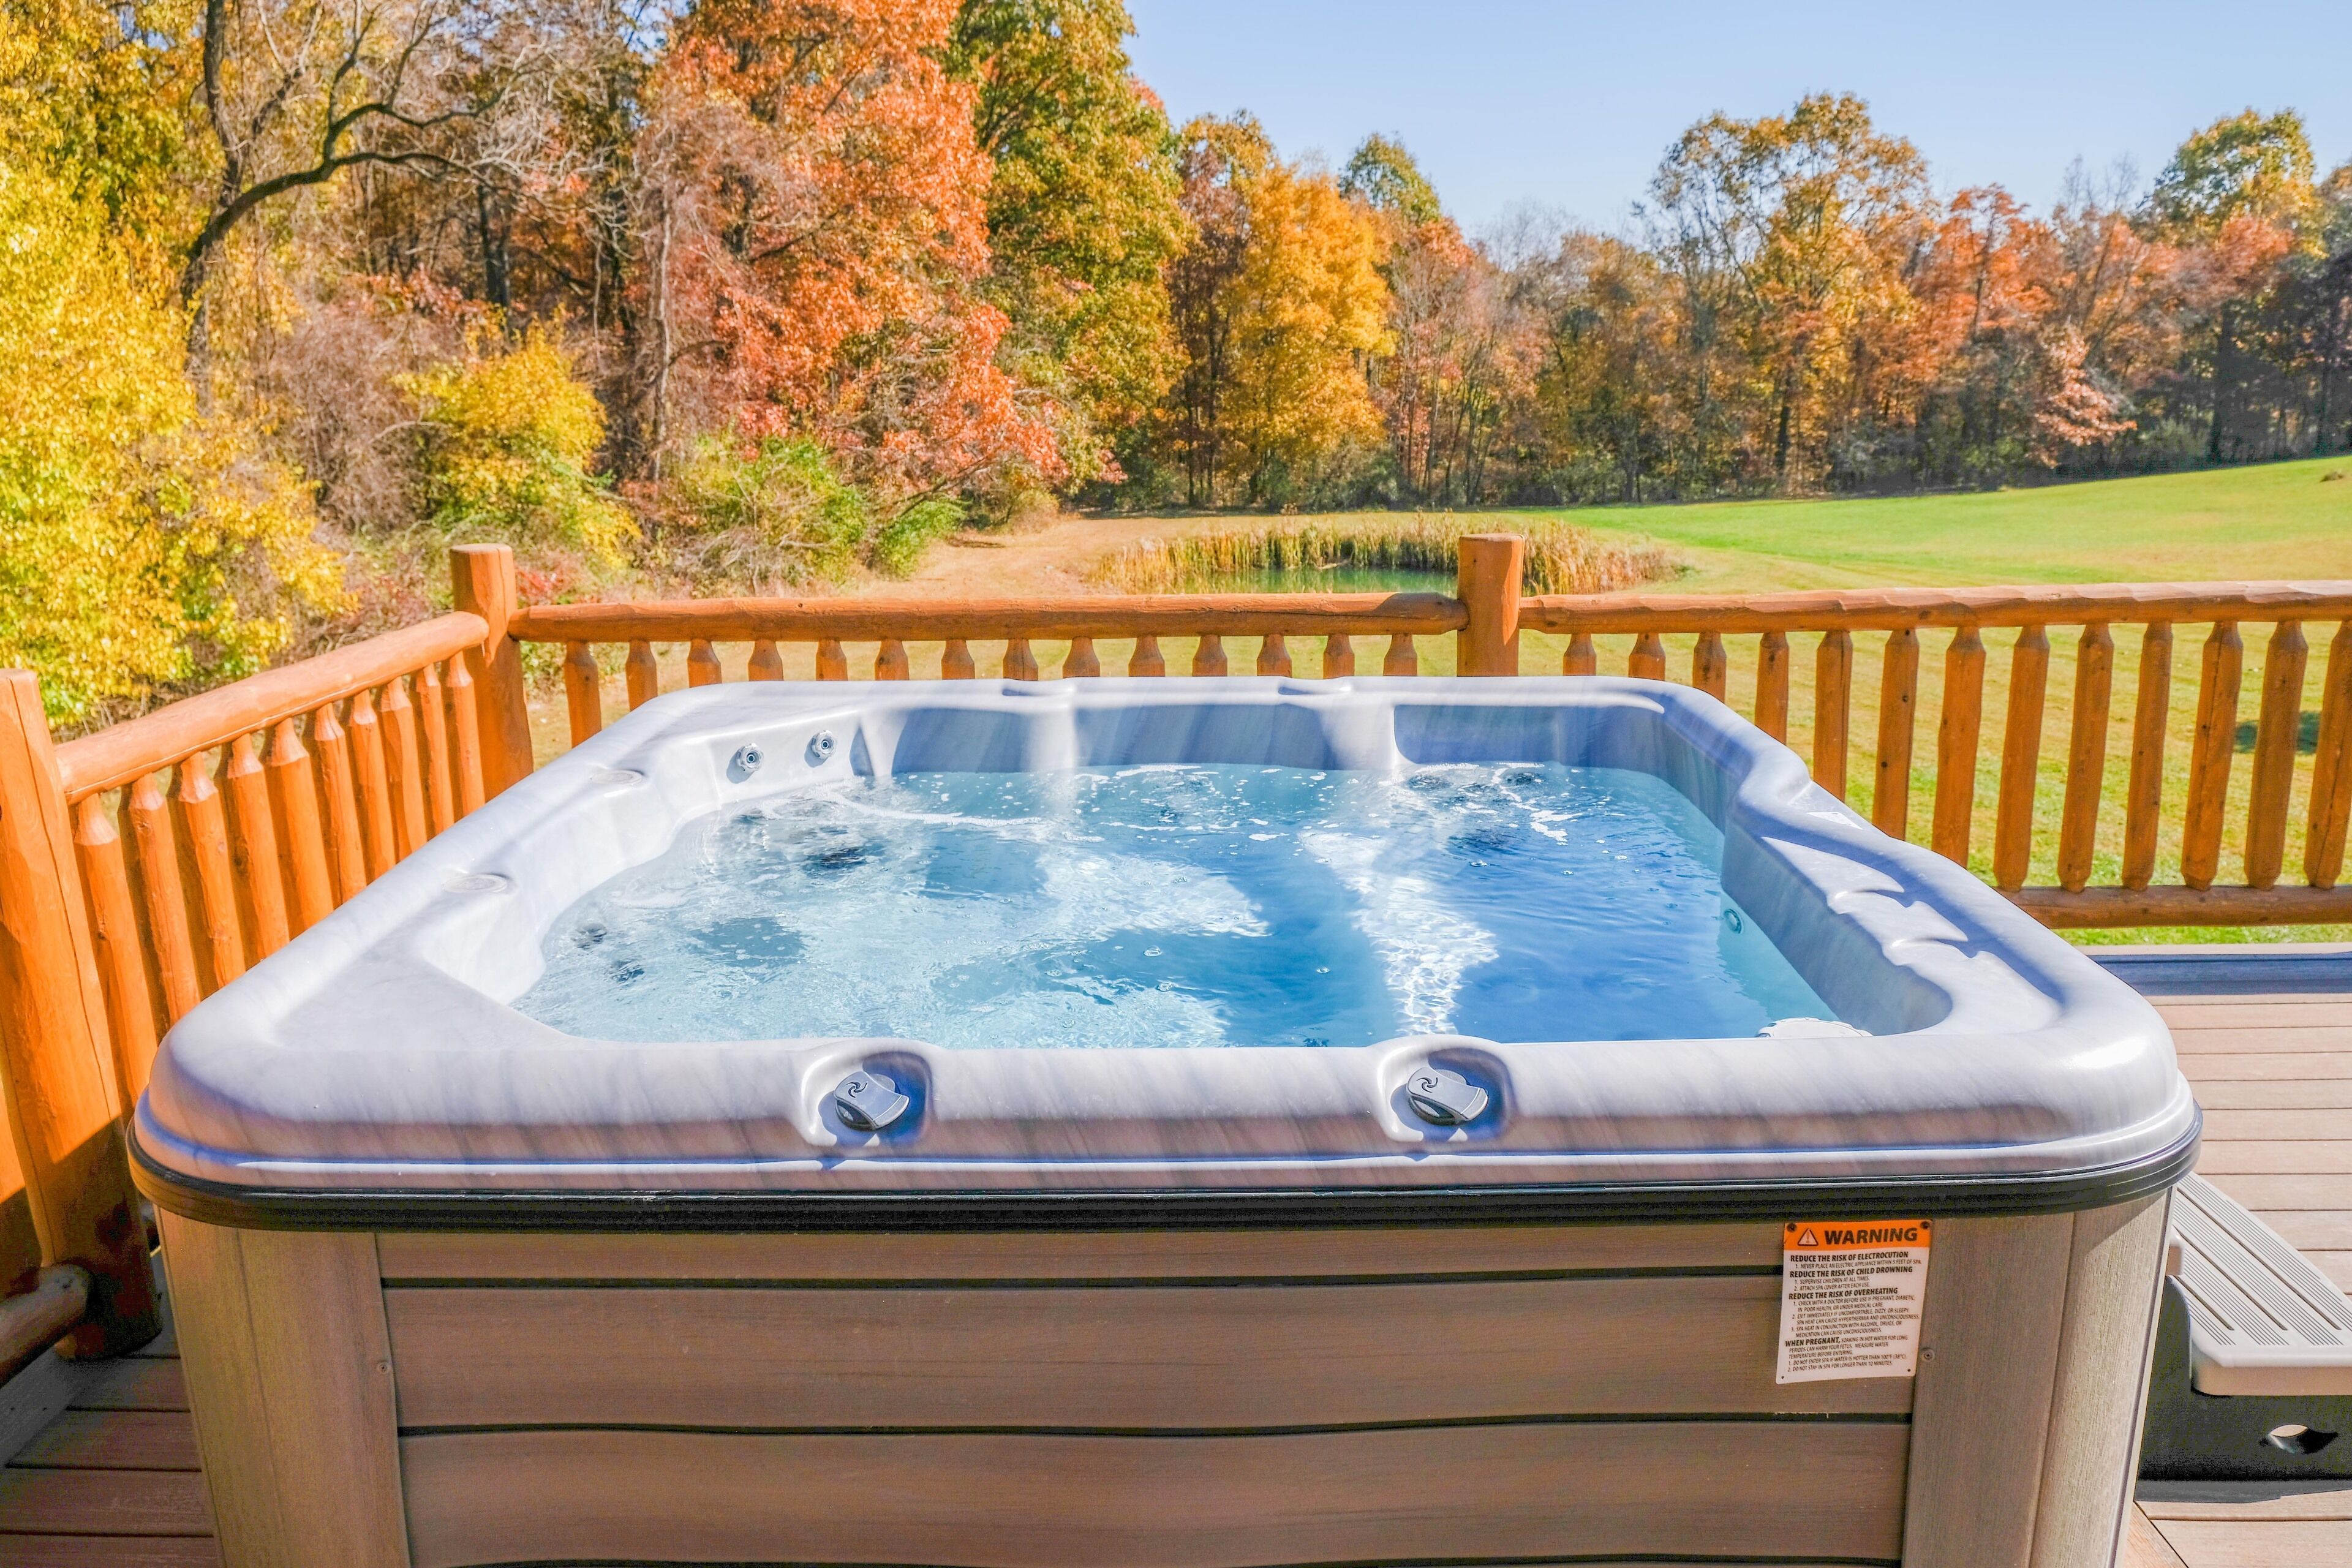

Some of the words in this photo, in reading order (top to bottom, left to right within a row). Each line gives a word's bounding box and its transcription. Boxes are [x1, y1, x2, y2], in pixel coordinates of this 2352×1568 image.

[1825, 1227, 1918, 1245] WARNING
[1858, 1251, 1908, 1260] ELECTROCUTION
[1854, 1288, 1898, 1296] OVERHEATING
[1806, 1337, 1840, 1345] PREGNANT,
